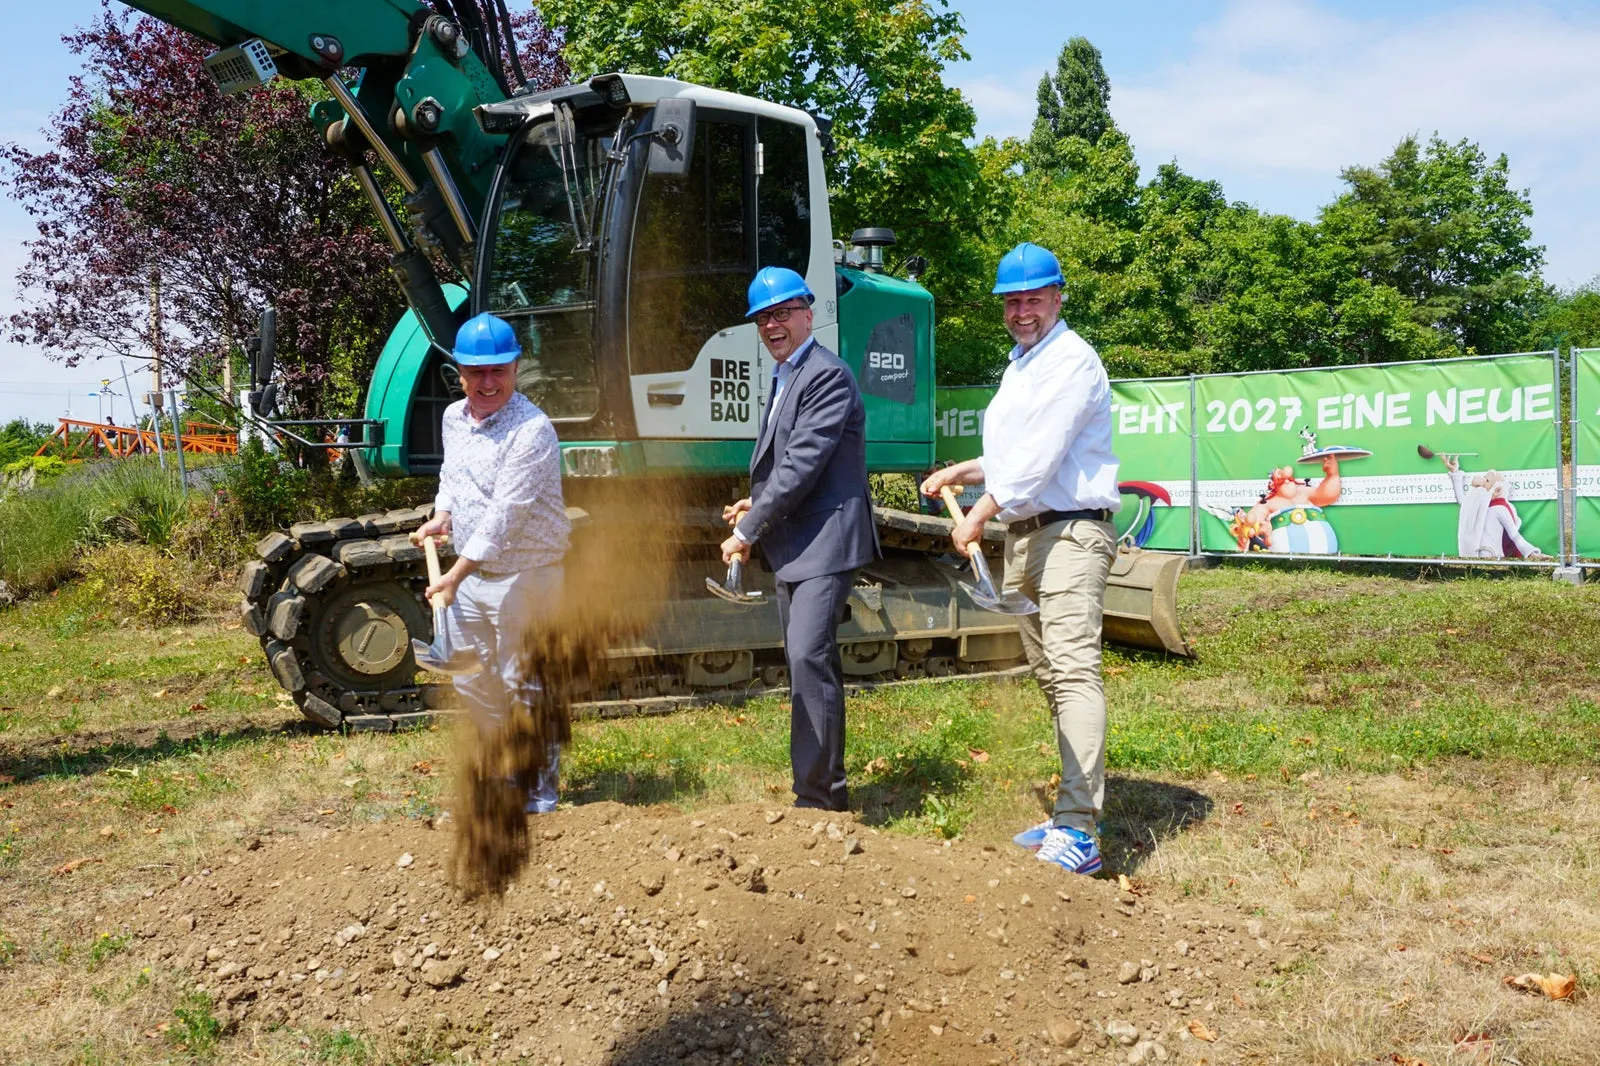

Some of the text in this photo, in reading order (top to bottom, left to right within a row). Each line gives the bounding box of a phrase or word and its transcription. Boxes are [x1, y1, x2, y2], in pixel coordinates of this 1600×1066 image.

[869, 351, 905, 370] 920
[725, 359, 750, 380] RE
[880, 369, 909, 382] compact
[710, 380, 750, 402] PRO
[711, 402, 750, 423] BAU
[1111, 401, 1185, 435] EHT
[1206, 397, 1302, 432] 2027
[1426, 383, 1554, 428] NEUE
[1523, 480, 1543, 489] LOS
[1576, 477, 1594, 486] 027
[1205, 490, 1223, 498] 2027
[1340, 484, 1443, 496] OS 2027 GEHT'S LOS
